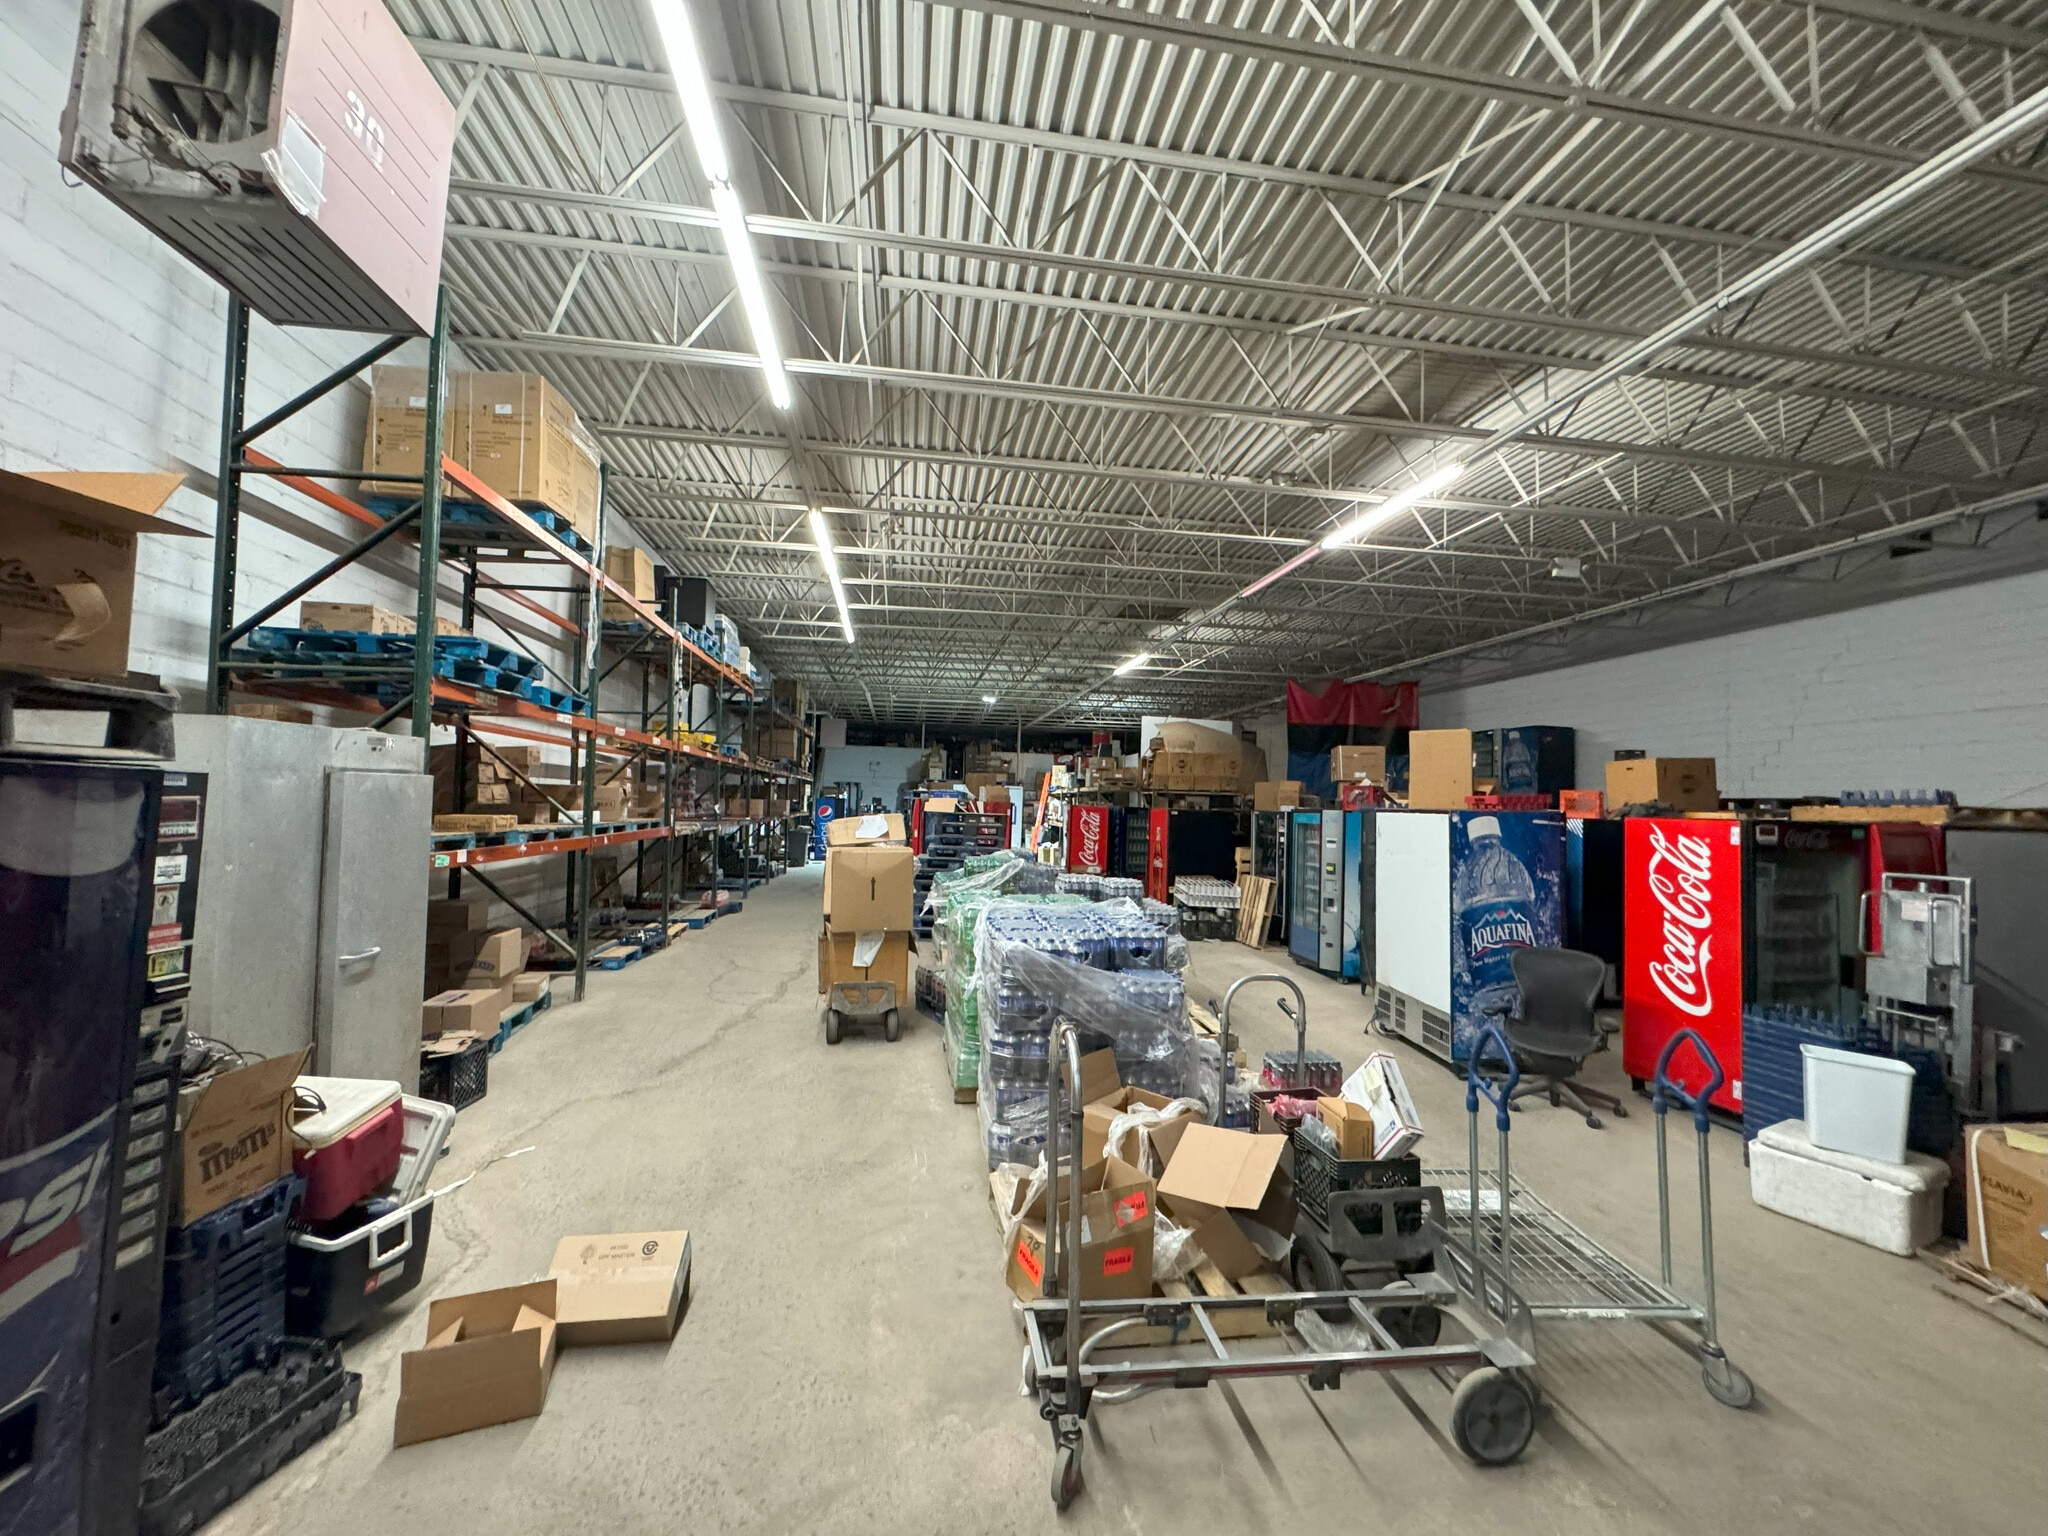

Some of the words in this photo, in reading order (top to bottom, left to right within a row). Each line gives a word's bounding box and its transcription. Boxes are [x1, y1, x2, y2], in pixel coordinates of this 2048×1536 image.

[1079, 808, 1101, 866] Coca-Cola
[1472, 919, 1536, 957] AQUAFINA
[1649, 822, 1713, 1017] Coca-Cola
